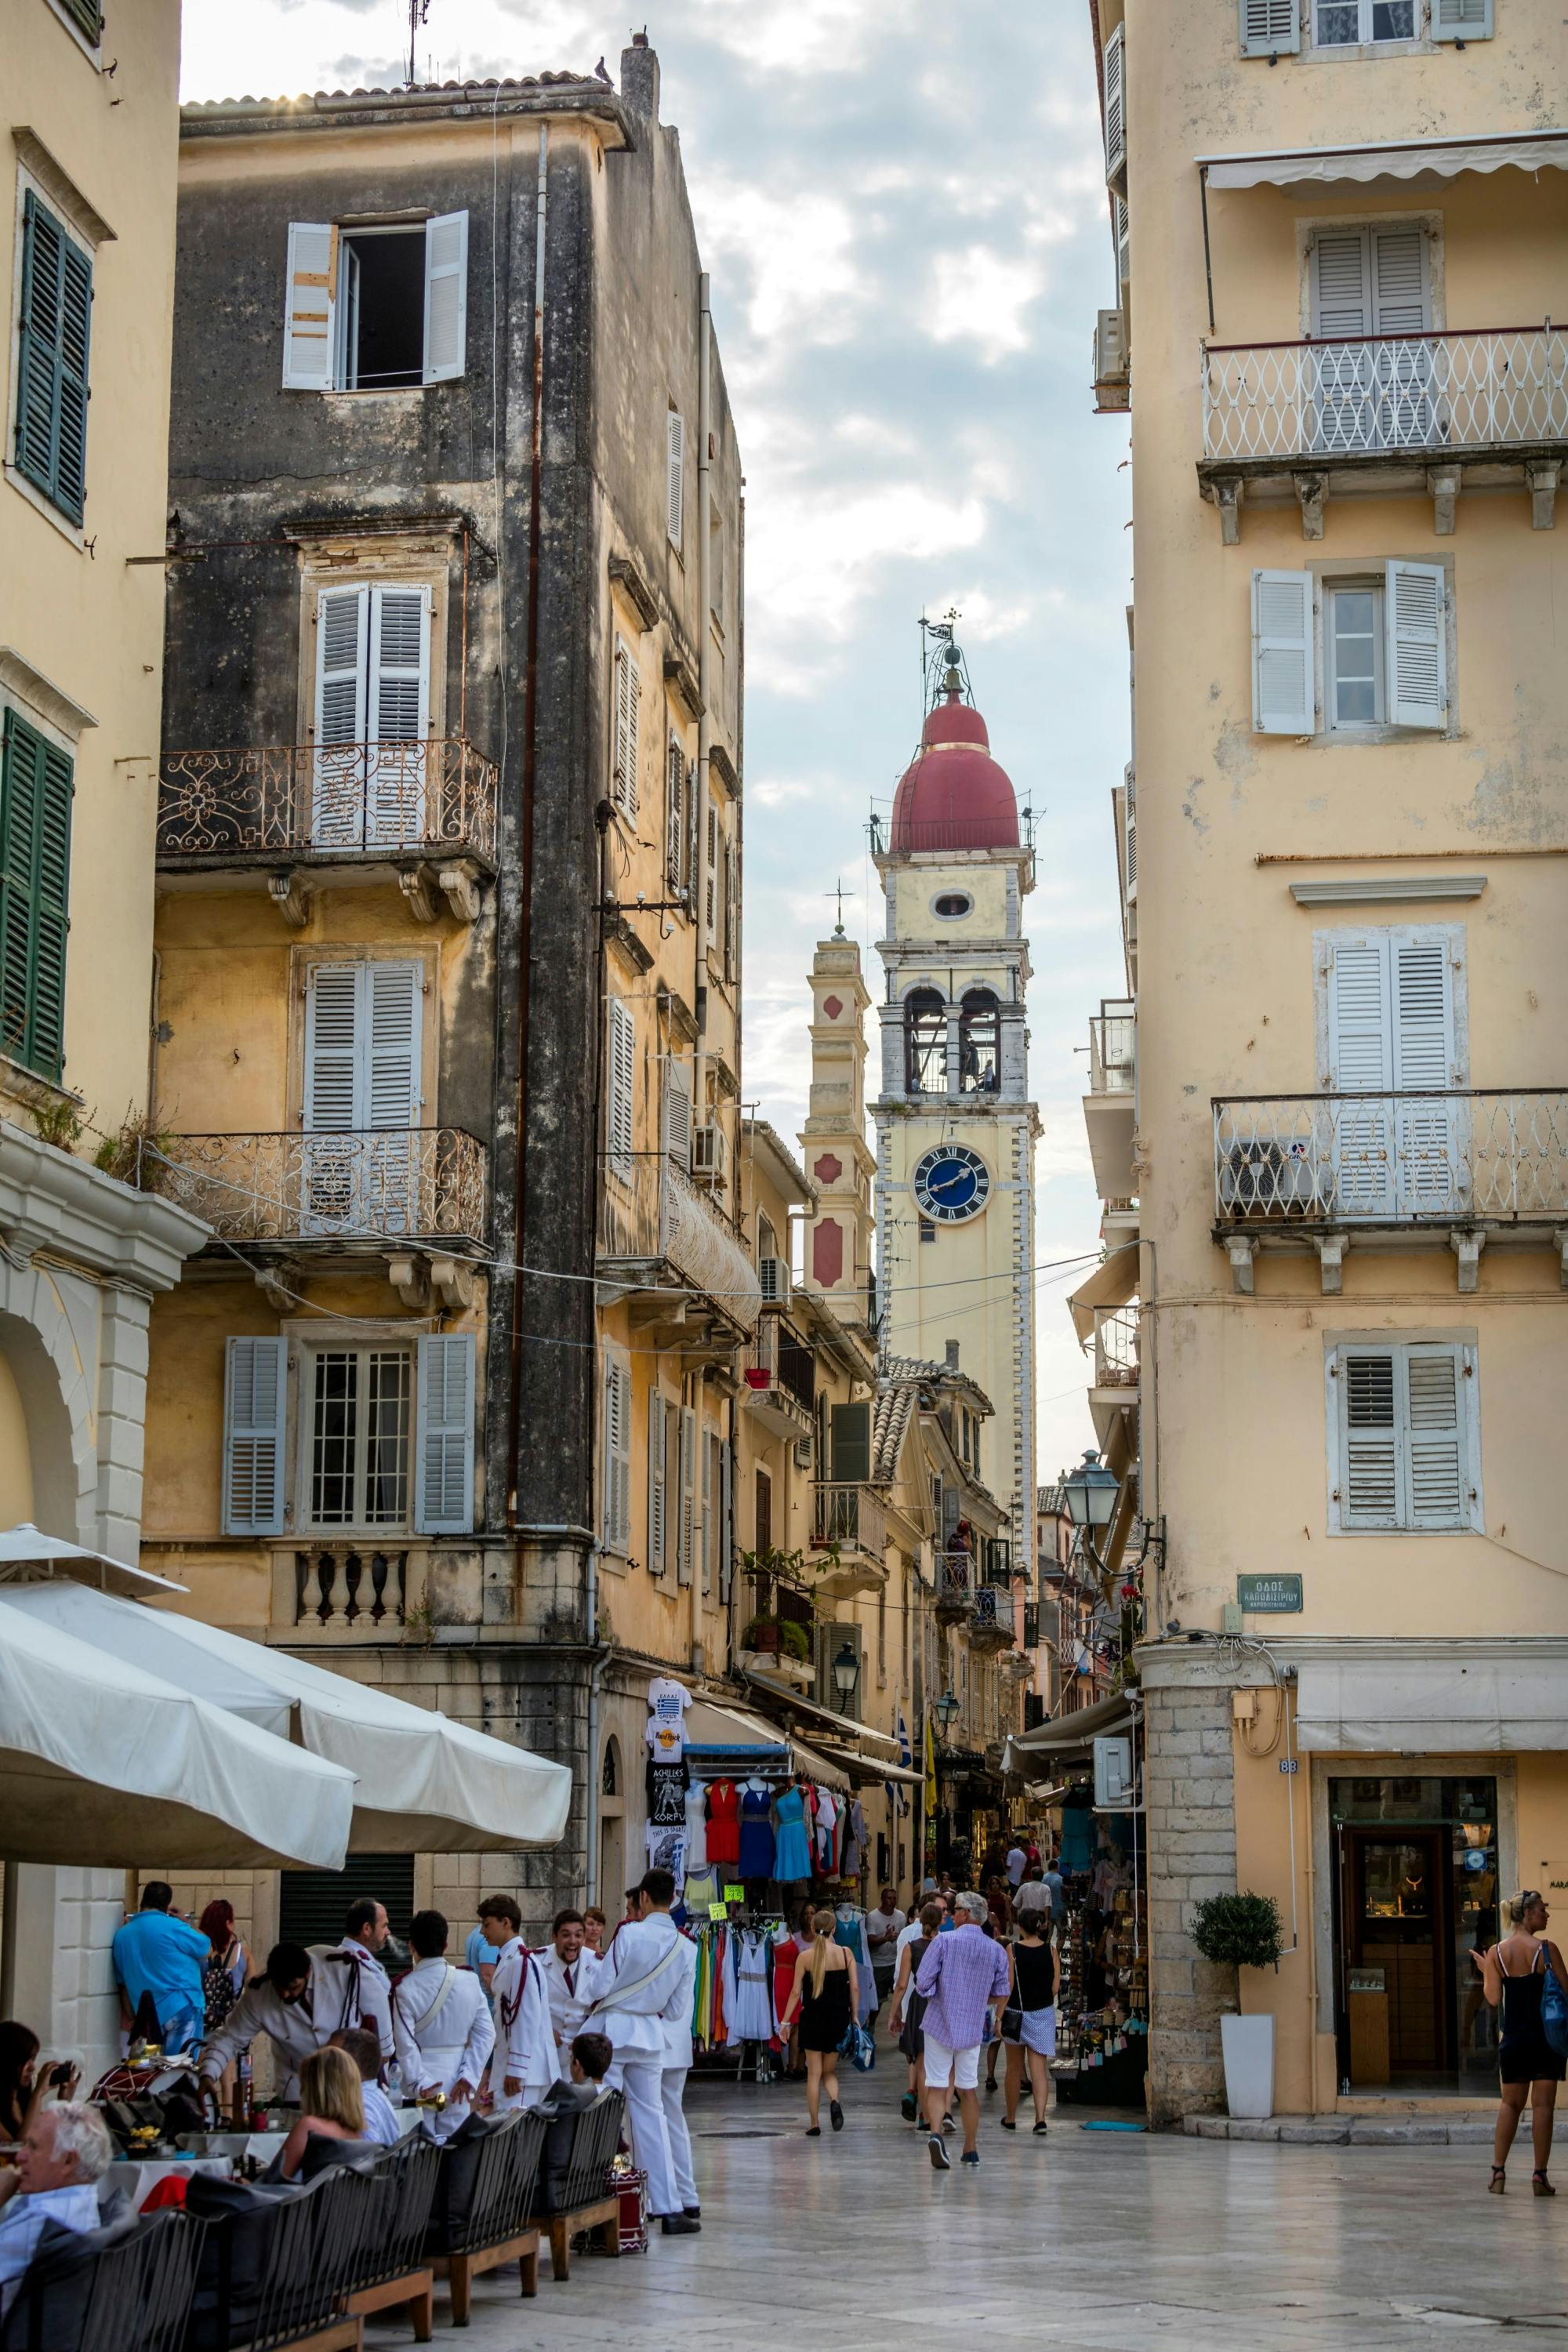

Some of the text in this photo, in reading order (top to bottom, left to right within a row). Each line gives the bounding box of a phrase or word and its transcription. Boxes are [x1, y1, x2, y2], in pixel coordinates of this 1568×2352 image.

[930, 1151, 941, 1163] XI
[946, 1147, 957, 1157] XII
[920, 1163, 929, 1172] X
[964, 1205, 972, 1215] V
[1256, 1581, 1283, 1592] ΟΔΟΣ
[655, 1731, 681, 1742] Hard Rock
[1280, 1761, 1297, 1772] 88
[653, 1769, 684, 1777] ACHILLES
[652, 1828, 663, 1838] THIS
